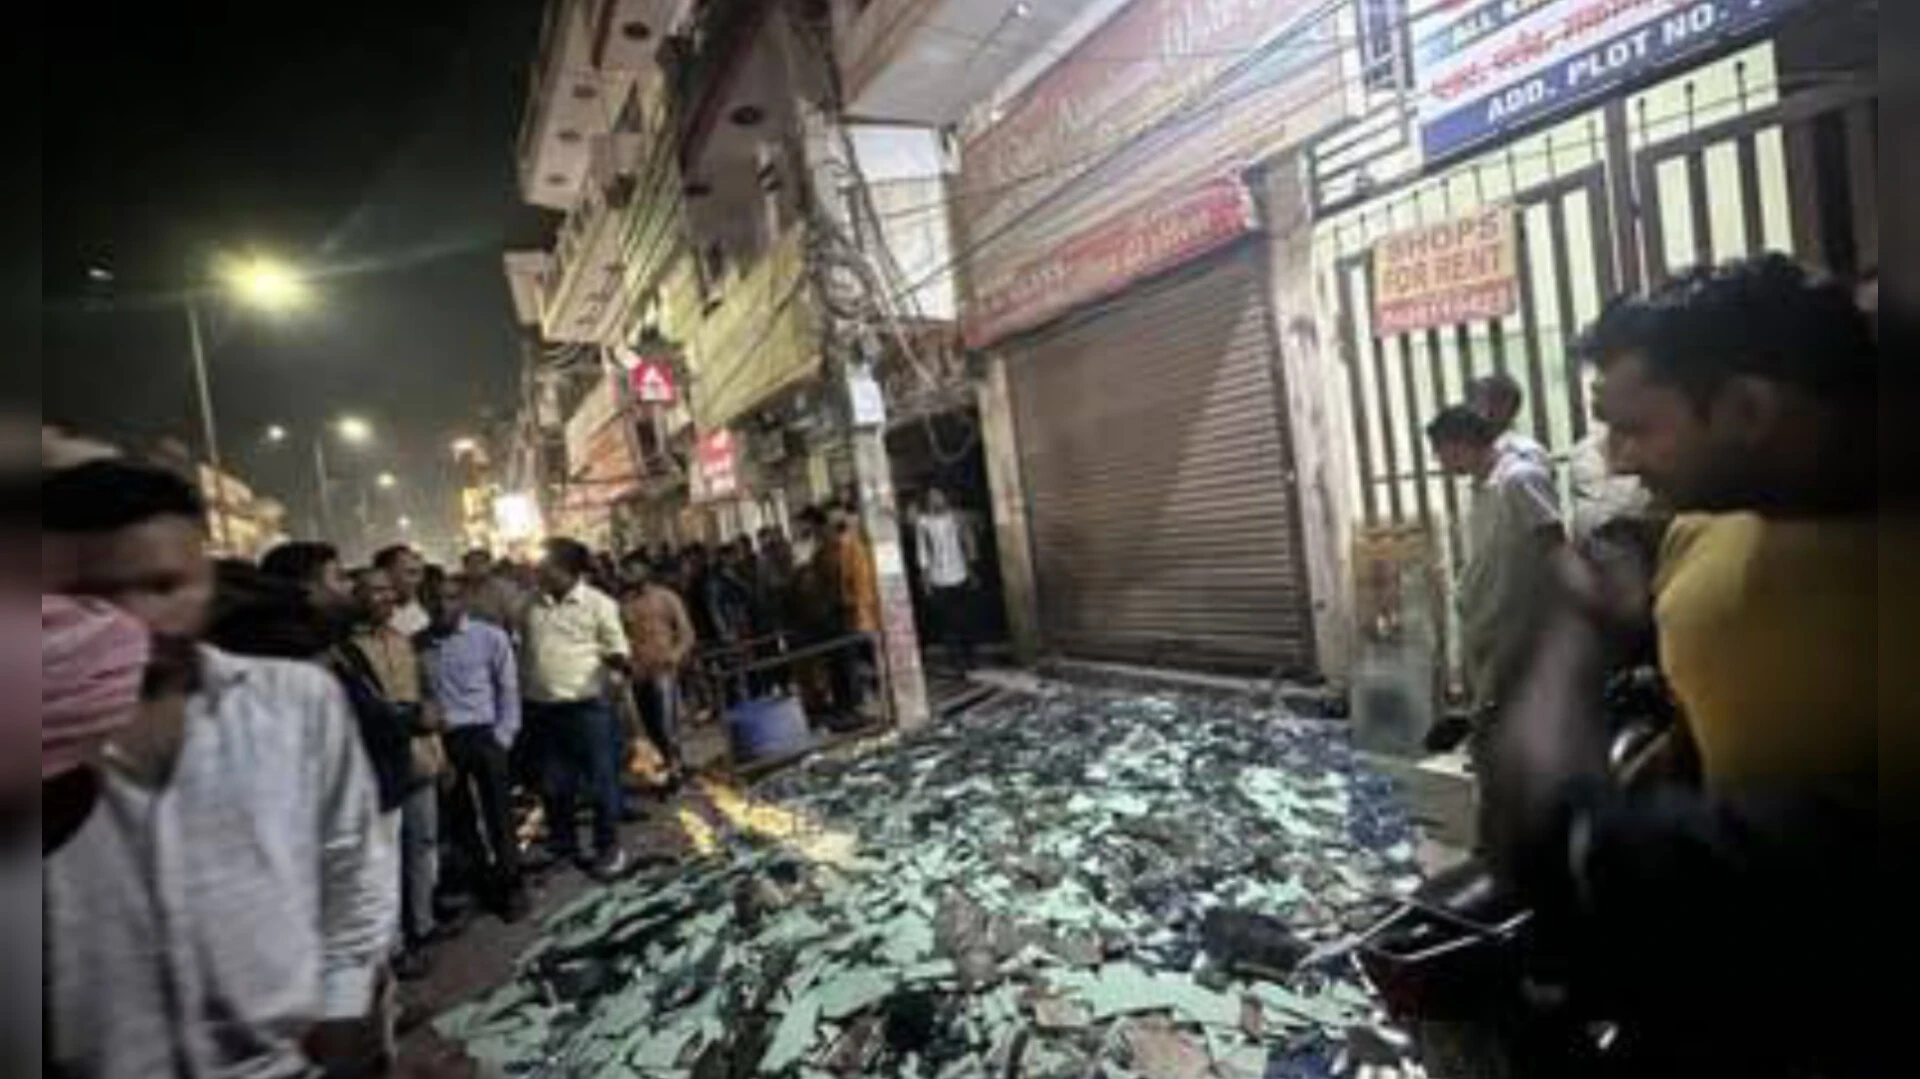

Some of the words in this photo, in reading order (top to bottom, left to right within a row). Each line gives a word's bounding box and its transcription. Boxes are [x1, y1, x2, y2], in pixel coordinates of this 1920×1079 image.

[1487, 76, 1557, 124] ADD.
[1567, 28, 1650, 86] PLOT
[1661, 2, 1729, 46] NO.
[1387, 207, 1498, 266] SHOPS
[1382, 260, 1427, 294] FOR
[1434, 243, 1500, 284] RENT
